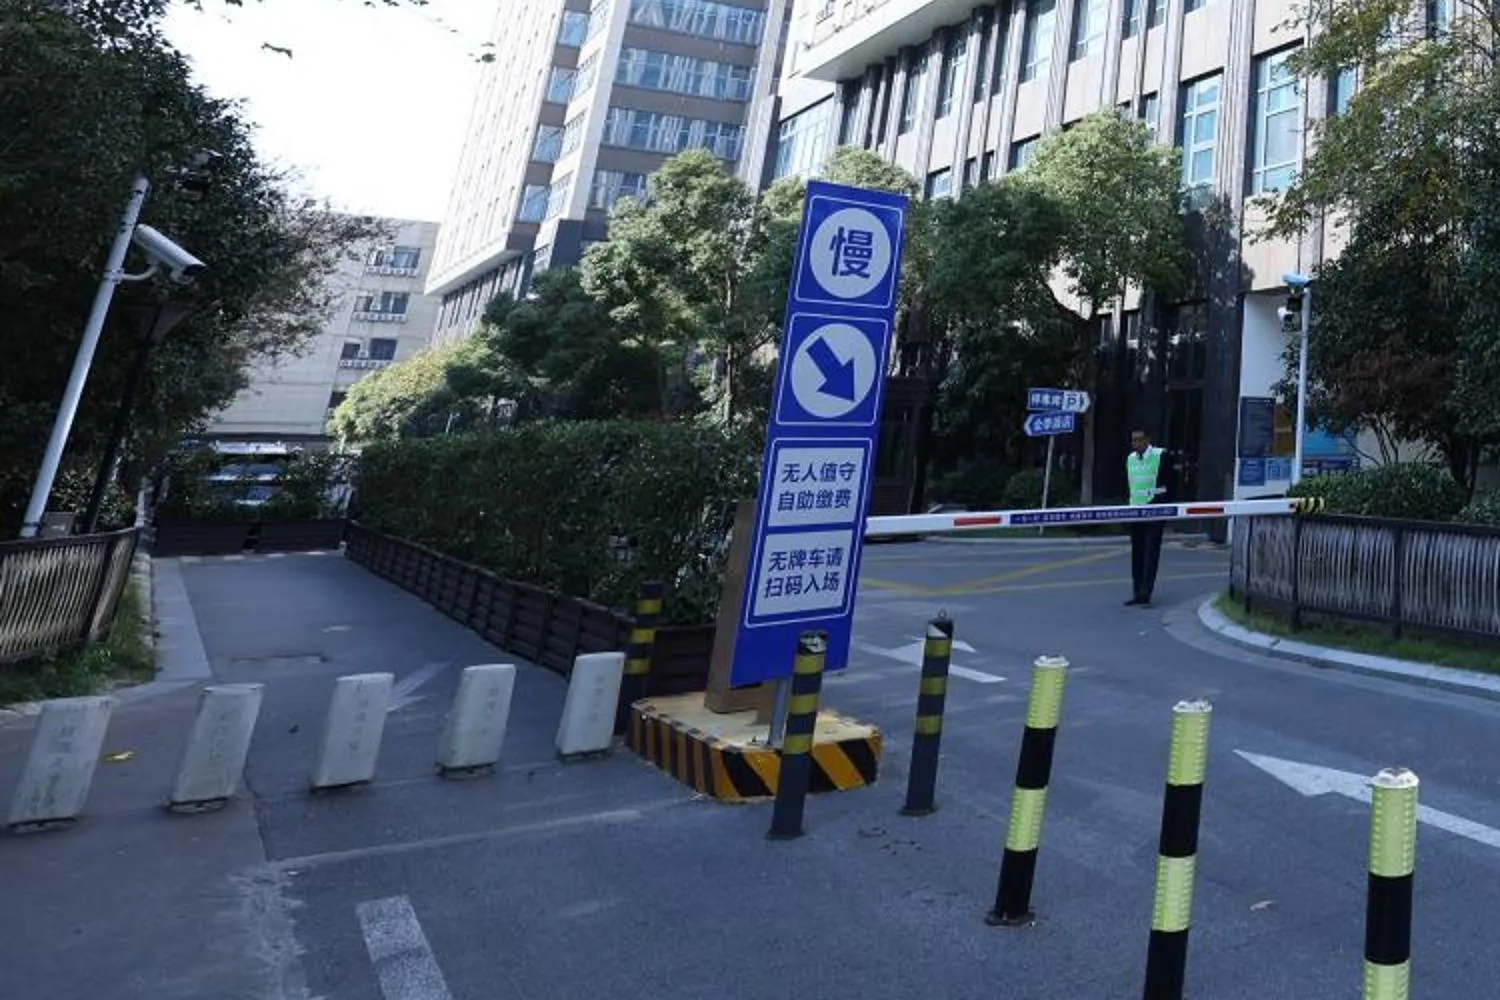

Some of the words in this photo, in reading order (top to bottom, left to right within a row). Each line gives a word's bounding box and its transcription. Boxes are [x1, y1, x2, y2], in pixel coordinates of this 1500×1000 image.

[829, 226, 874, 281] 慢
[782, 462, 857, 483] 无人值守
[777, 489, 852, 512] 自助缴费
[768, 547, 844, 573] 无牌车请
[764, 572, 841, 599] 扫码入场
